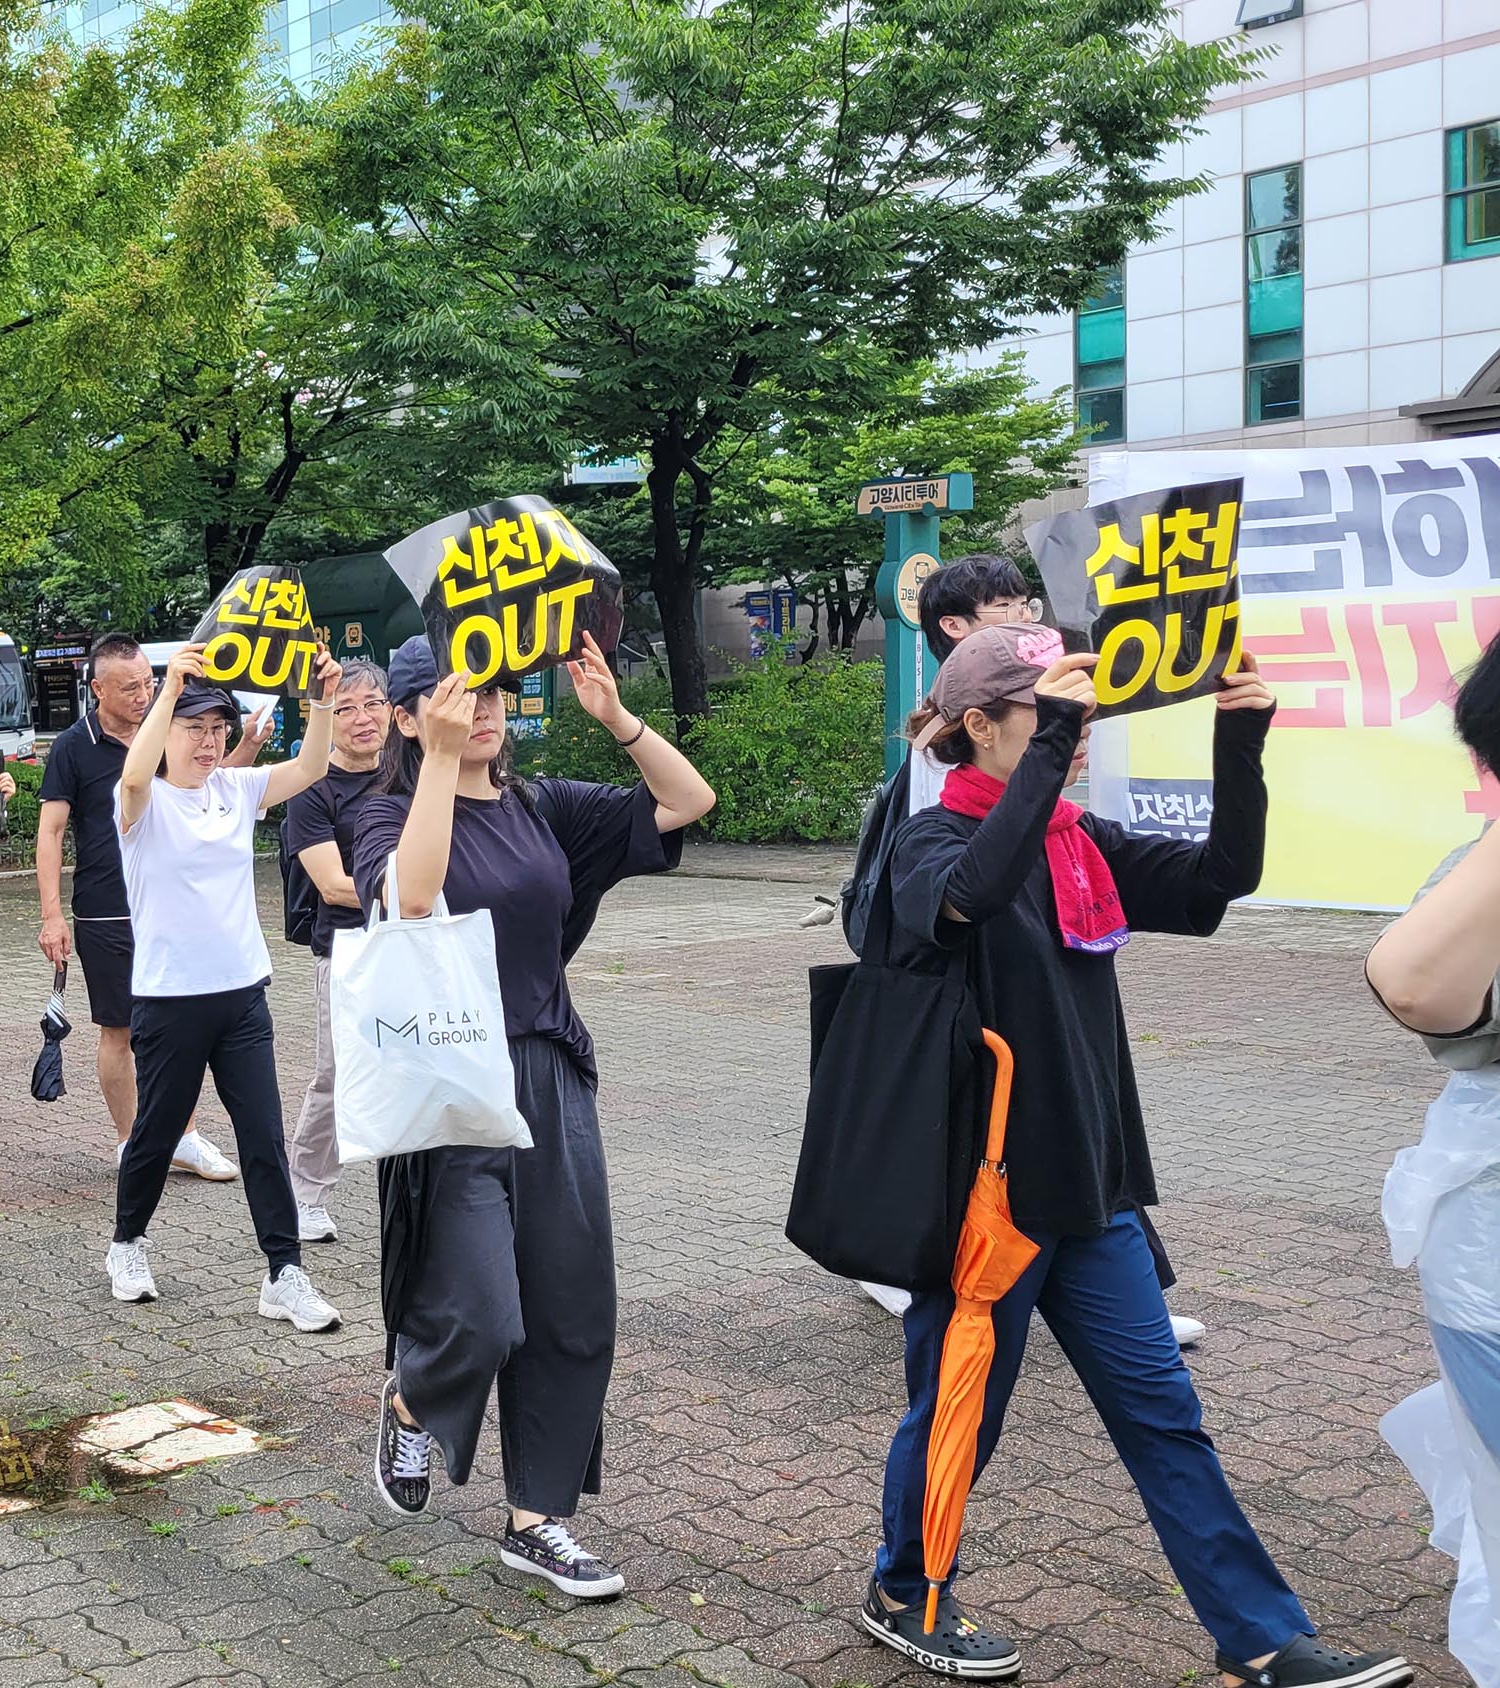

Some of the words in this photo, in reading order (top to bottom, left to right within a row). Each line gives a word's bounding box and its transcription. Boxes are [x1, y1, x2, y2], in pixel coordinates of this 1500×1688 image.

[868, 483, 939, 505] 고양시티투어
[437, 510, 592, 608] 신천지
[1085, 502, 1244, 607] 신천
[900, 588, 918, 601] 고양
[451, 578, 595, 689] OUT
[1092, 600, 1243, 705] OUT
[202, 632, 318, 690] OUT
[428, 1009, 482, 1026] PLAY
[428, 1028, 488, 1046] GROUND
[905, 1644, 960, 1674] crocs
